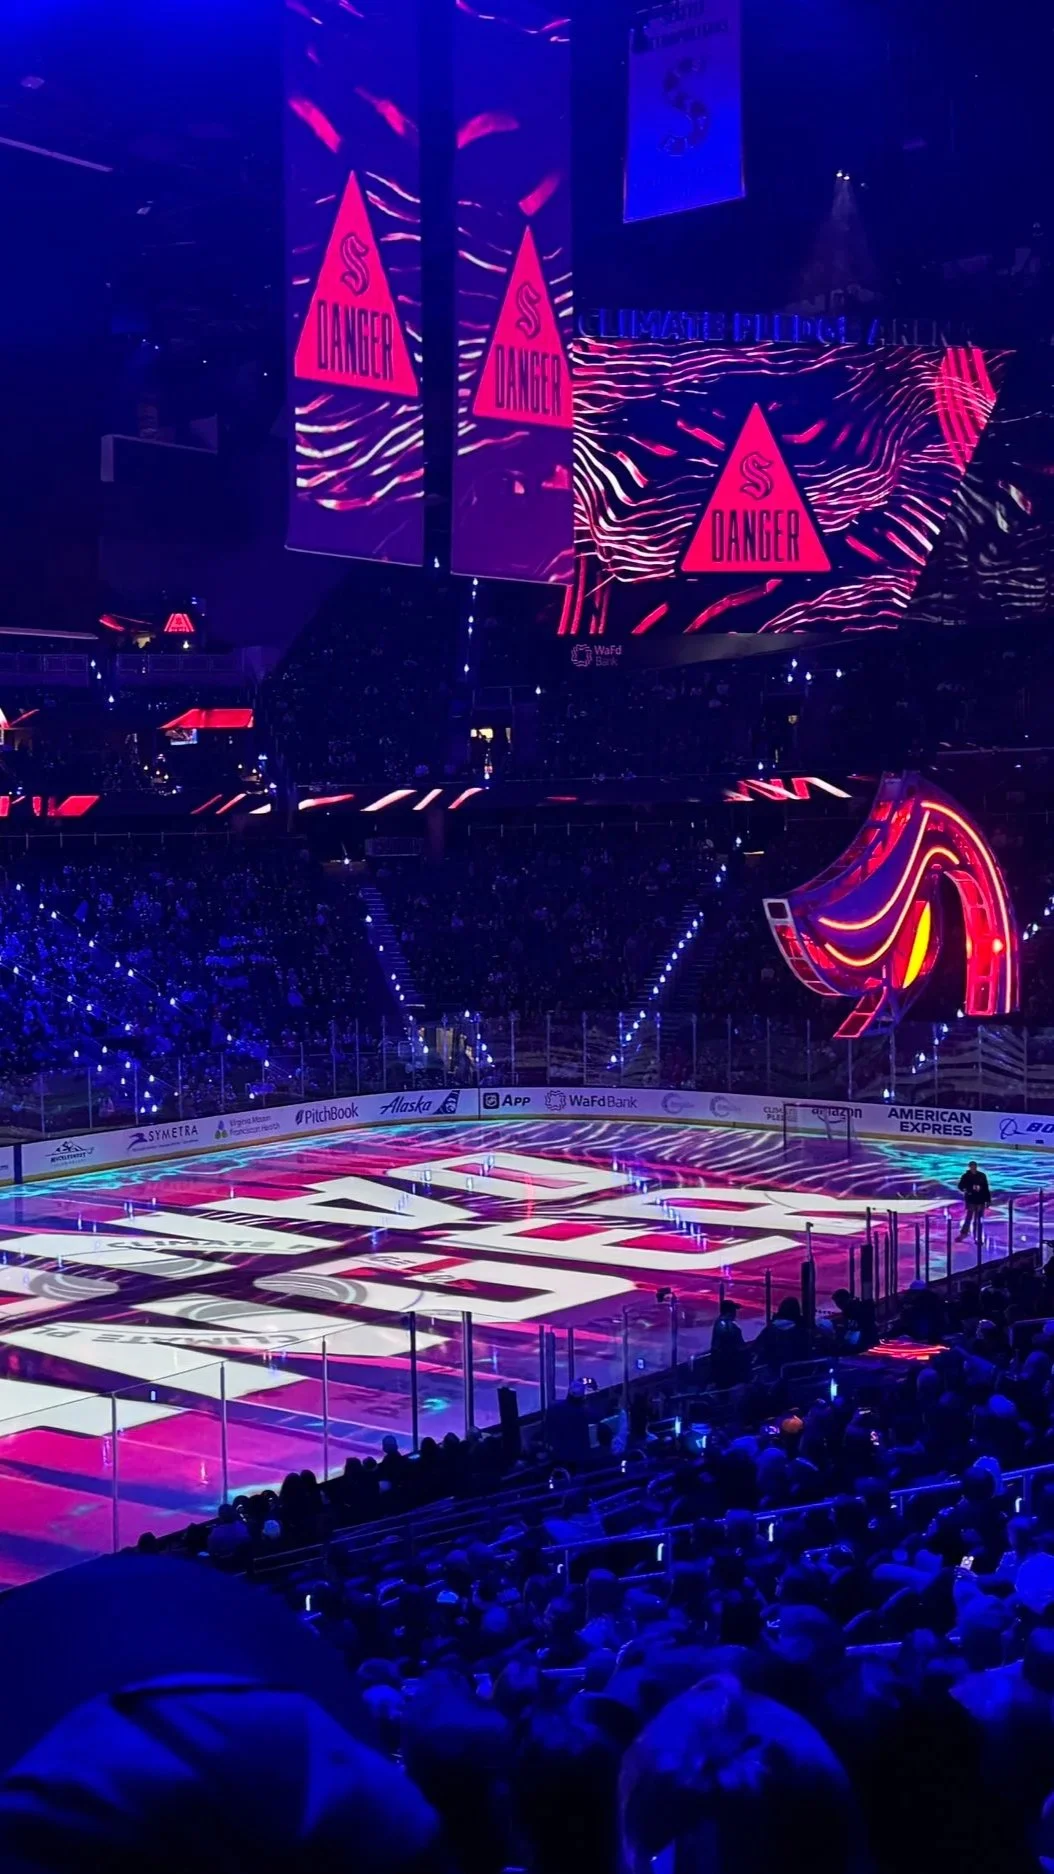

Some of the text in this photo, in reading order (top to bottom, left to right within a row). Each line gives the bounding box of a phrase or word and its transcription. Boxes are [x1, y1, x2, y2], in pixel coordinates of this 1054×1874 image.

[578, 307, 725, 340] CLIMATE
[317, 299, 394, 382] DANGER
[495, 344, 562, 417] DANGER
[711, 508, 800, 563] DANGER
[593, 644, 622, 655] WaFd
[305, 1102, 360, 1124] PitchBook
[380, 1095, 433, 1115] Alaska
[887, 1107, 972, 1124] AMERICAN
[148, 1125, 199, 1142] SYMETRA
[900, 1121, 974, 1137] EXPRESS
[107, 1239, 275, 1249] CLIMATE
[92, 1333, 300, 1345] CLIMATE
